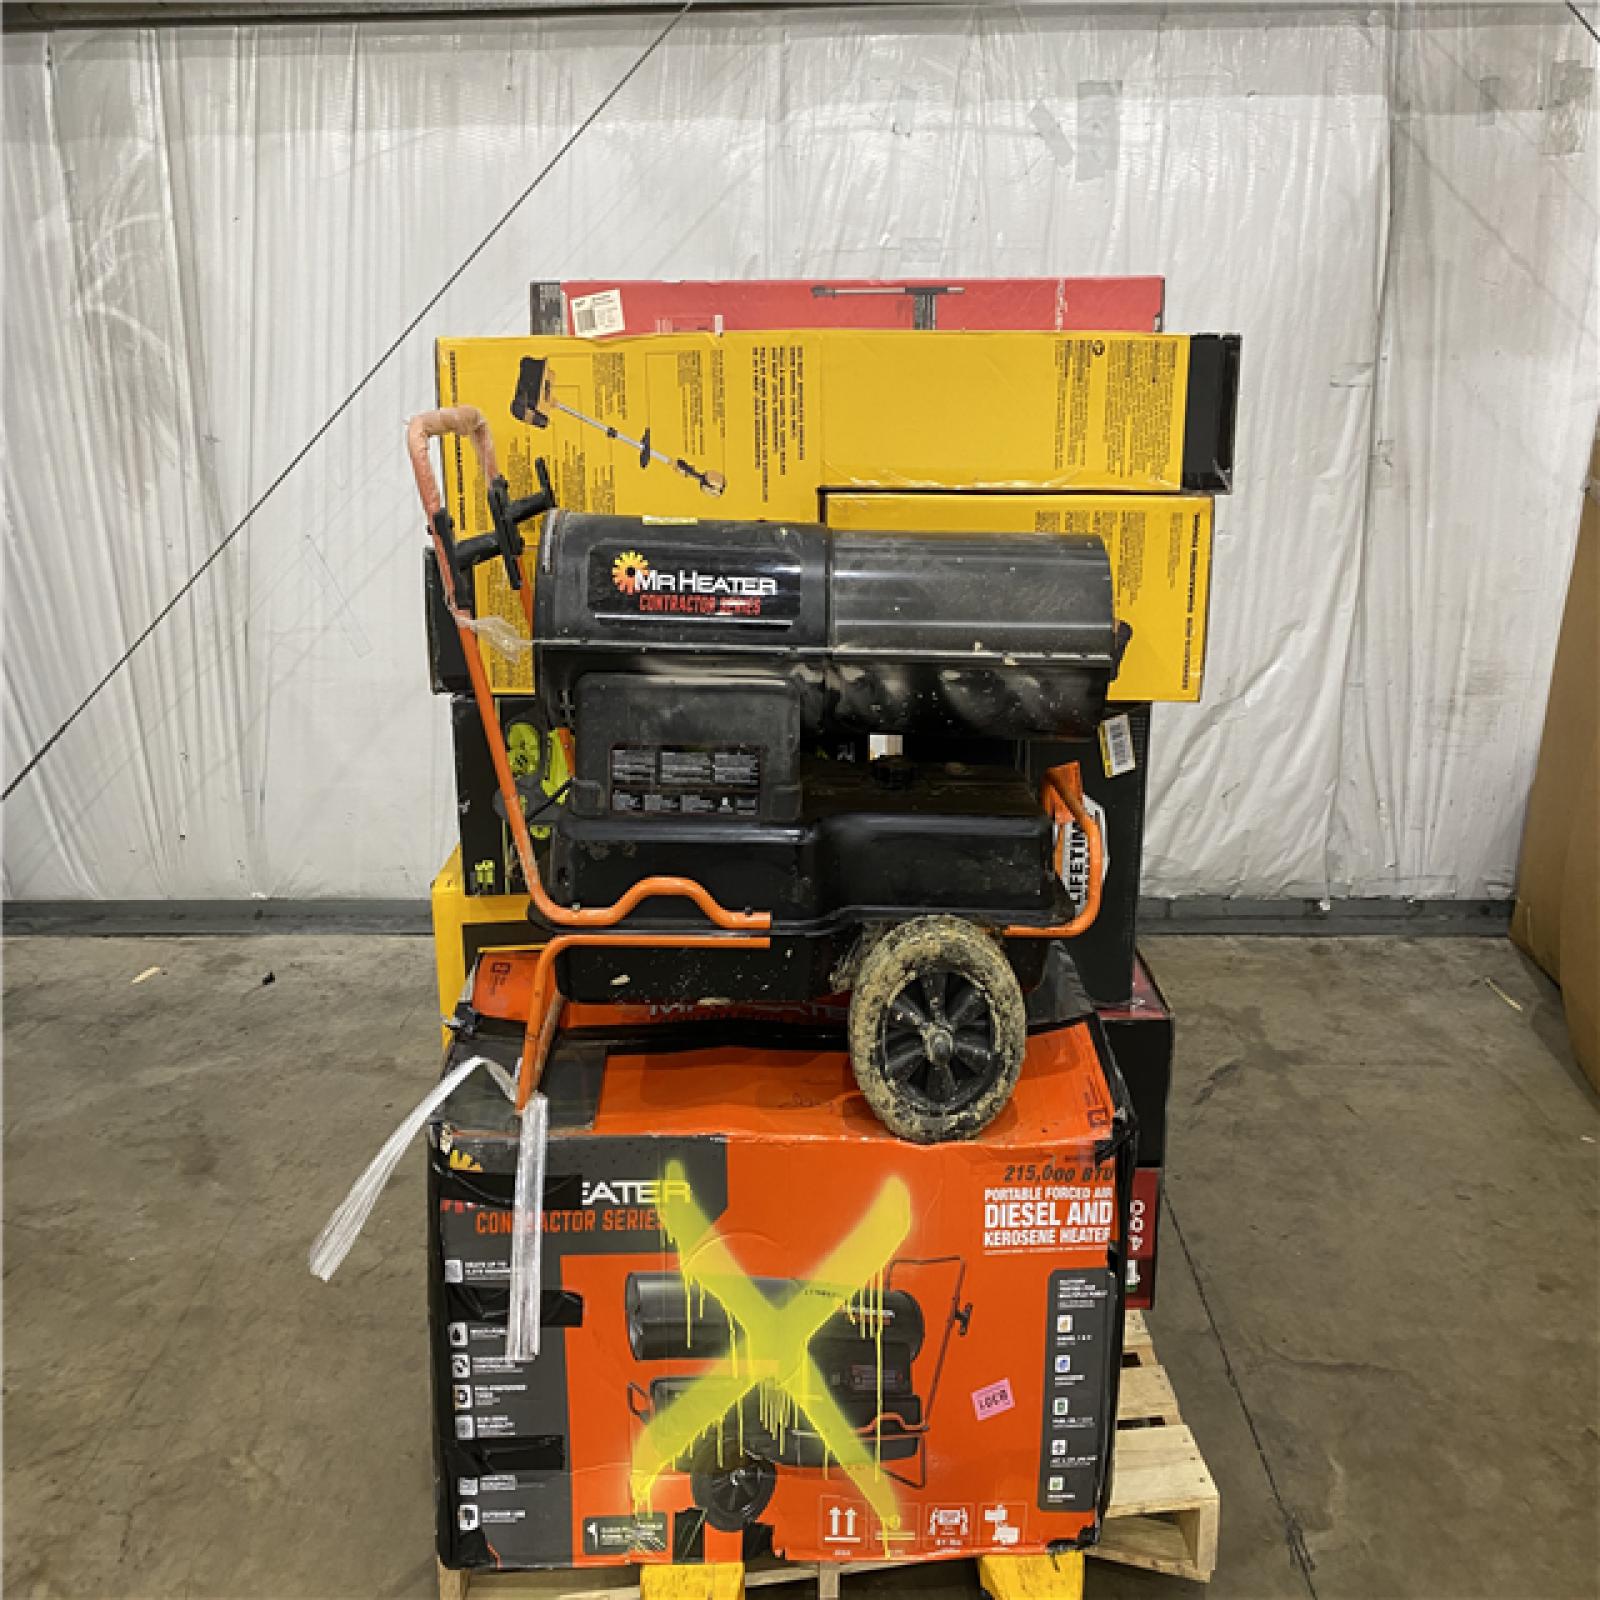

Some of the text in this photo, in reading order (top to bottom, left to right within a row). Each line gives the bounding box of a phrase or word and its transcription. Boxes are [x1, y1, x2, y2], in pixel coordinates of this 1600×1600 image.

[679, 569, 777, 596] HEATER
[639, 594, 716, 614] CONTRACTOR
[1069, 819, 1086, 906] LIFETIM
[582, 1180, 692, 1205] EATER
[984, 1186, 1113, 1202] PORTABLE FORCED AIR
[984, 1200, 1113, 1229] DIESEL AND
[984, 1227, 1111, 1247] KEROSENE HEATER
